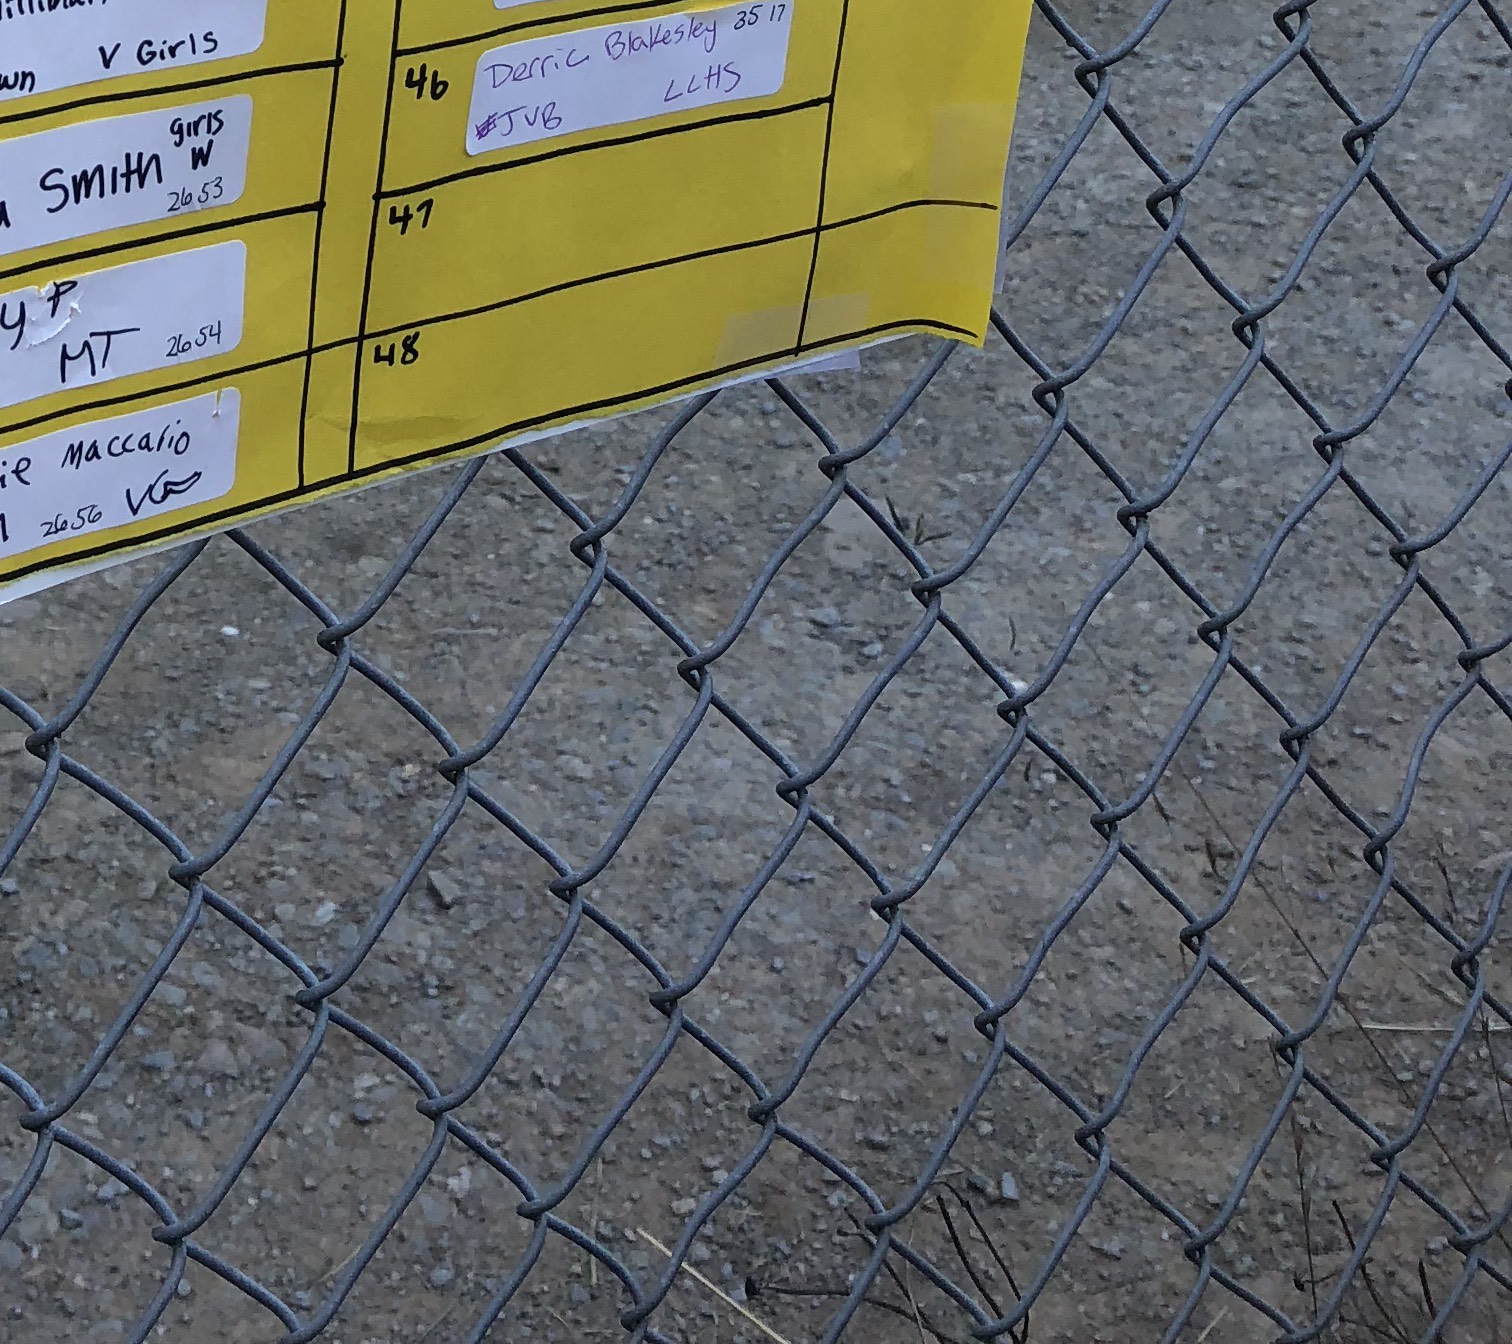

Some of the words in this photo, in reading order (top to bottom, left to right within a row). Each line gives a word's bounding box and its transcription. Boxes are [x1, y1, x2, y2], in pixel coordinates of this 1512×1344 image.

[405, 63, 449, 101] 46
[40, 152, 163, 213] Smith
[389, 198, 434, 235] 47
[55, 328, 140, 390] MT
